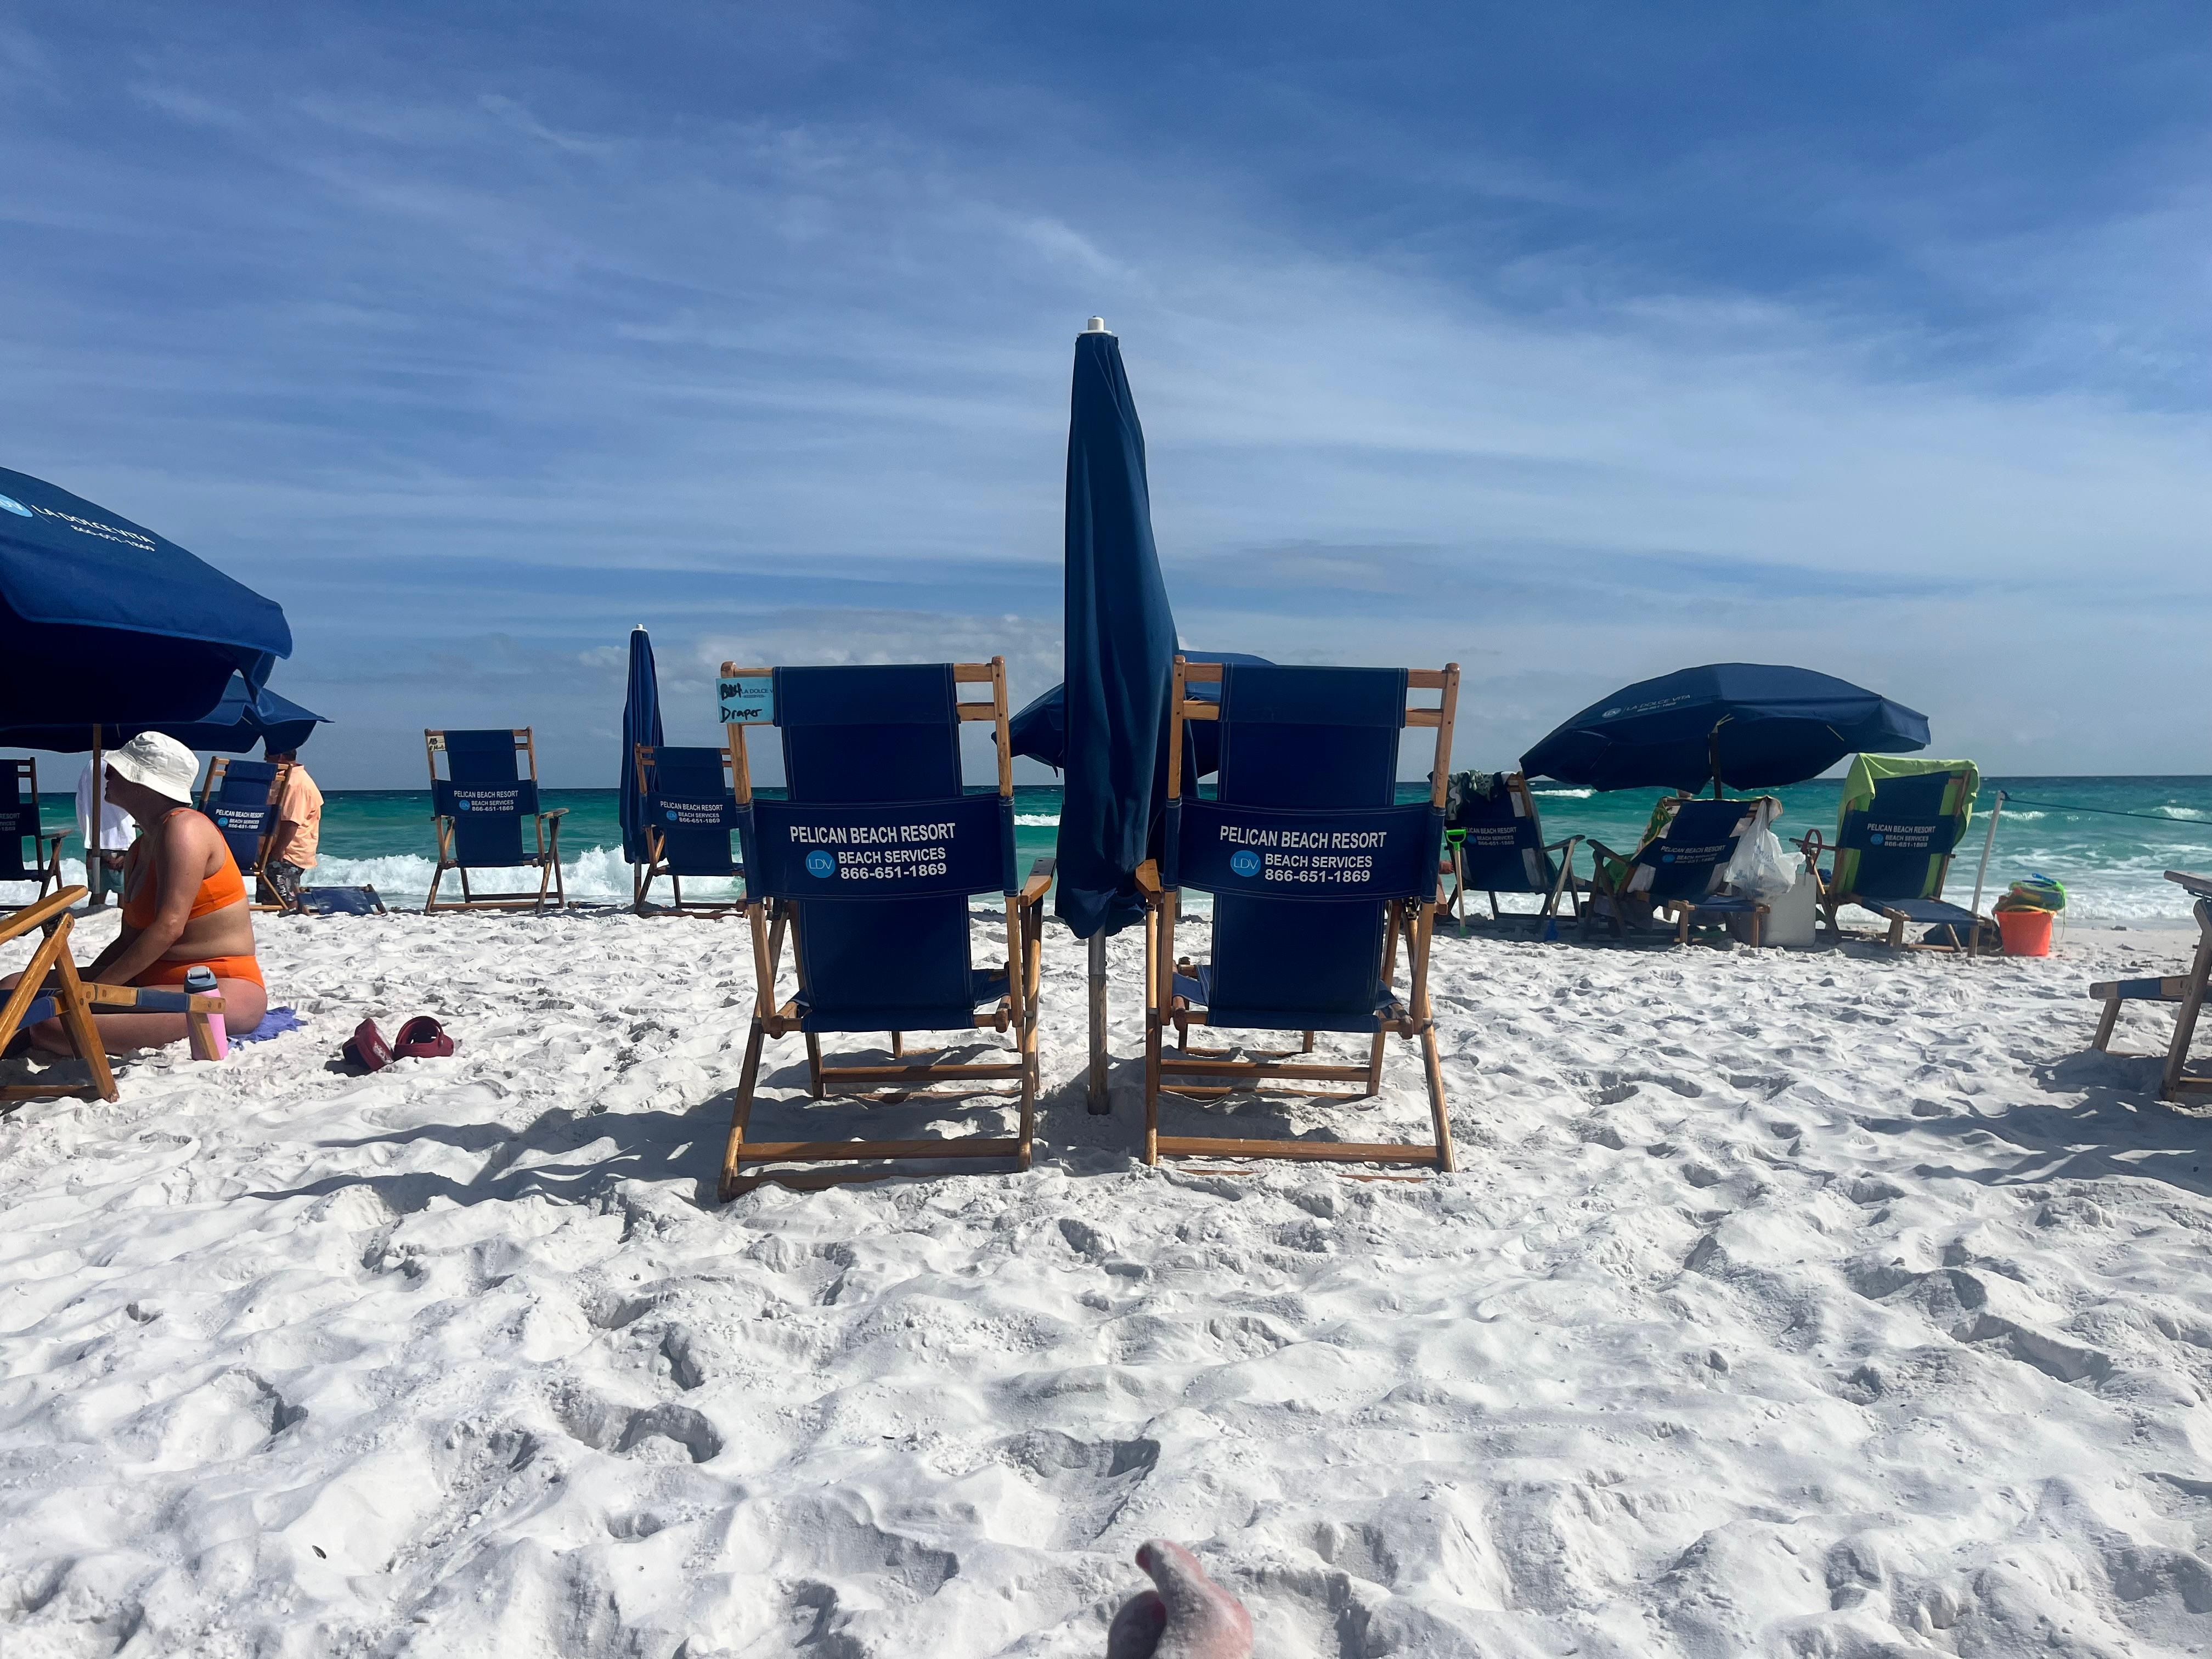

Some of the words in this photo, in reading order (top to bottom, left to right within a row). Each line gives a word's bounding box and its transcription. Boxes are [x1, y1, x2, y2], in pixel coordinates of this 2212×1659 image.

[31, 505, 60, 518] LA
[57, 512, 117, 534] DOLCE
[112, 527, 155, 544] VITA
[1640, 698, 1669, 708] DOLCE
[720, 706, 762, 723] Draper
[660, 801, 681, 809] PELICAN
[216, 809, 235, 817] PELICAN
[790, 826, 847, 844] PELICAN
[850, 826, 898, 844] BEACH
[901, 823, 956, 842] RESORT
[1867, 823, 1892, 832] PELICAN
[1220, 826, 1278, 847] PELICAN
[1281, 832, 1328, 849] BEACH
[1331, 832, 1387, 849] RESORT
[809, 857, 833, 870] LDV
[838, 851, 882, 865] BEACH
[884, 847, 946, 863] SERVICES
[1233, 857, 1259, 870] LDV
[1265, 853, 1308, 868] BEACH
[1312, 856, 1373, 868] SERVICES
[840, 863, 947, 879] 866-651-1869
[1265, 868, 1370, 883] 866-651-1869
[276, 874, 286, 896] Hurley
